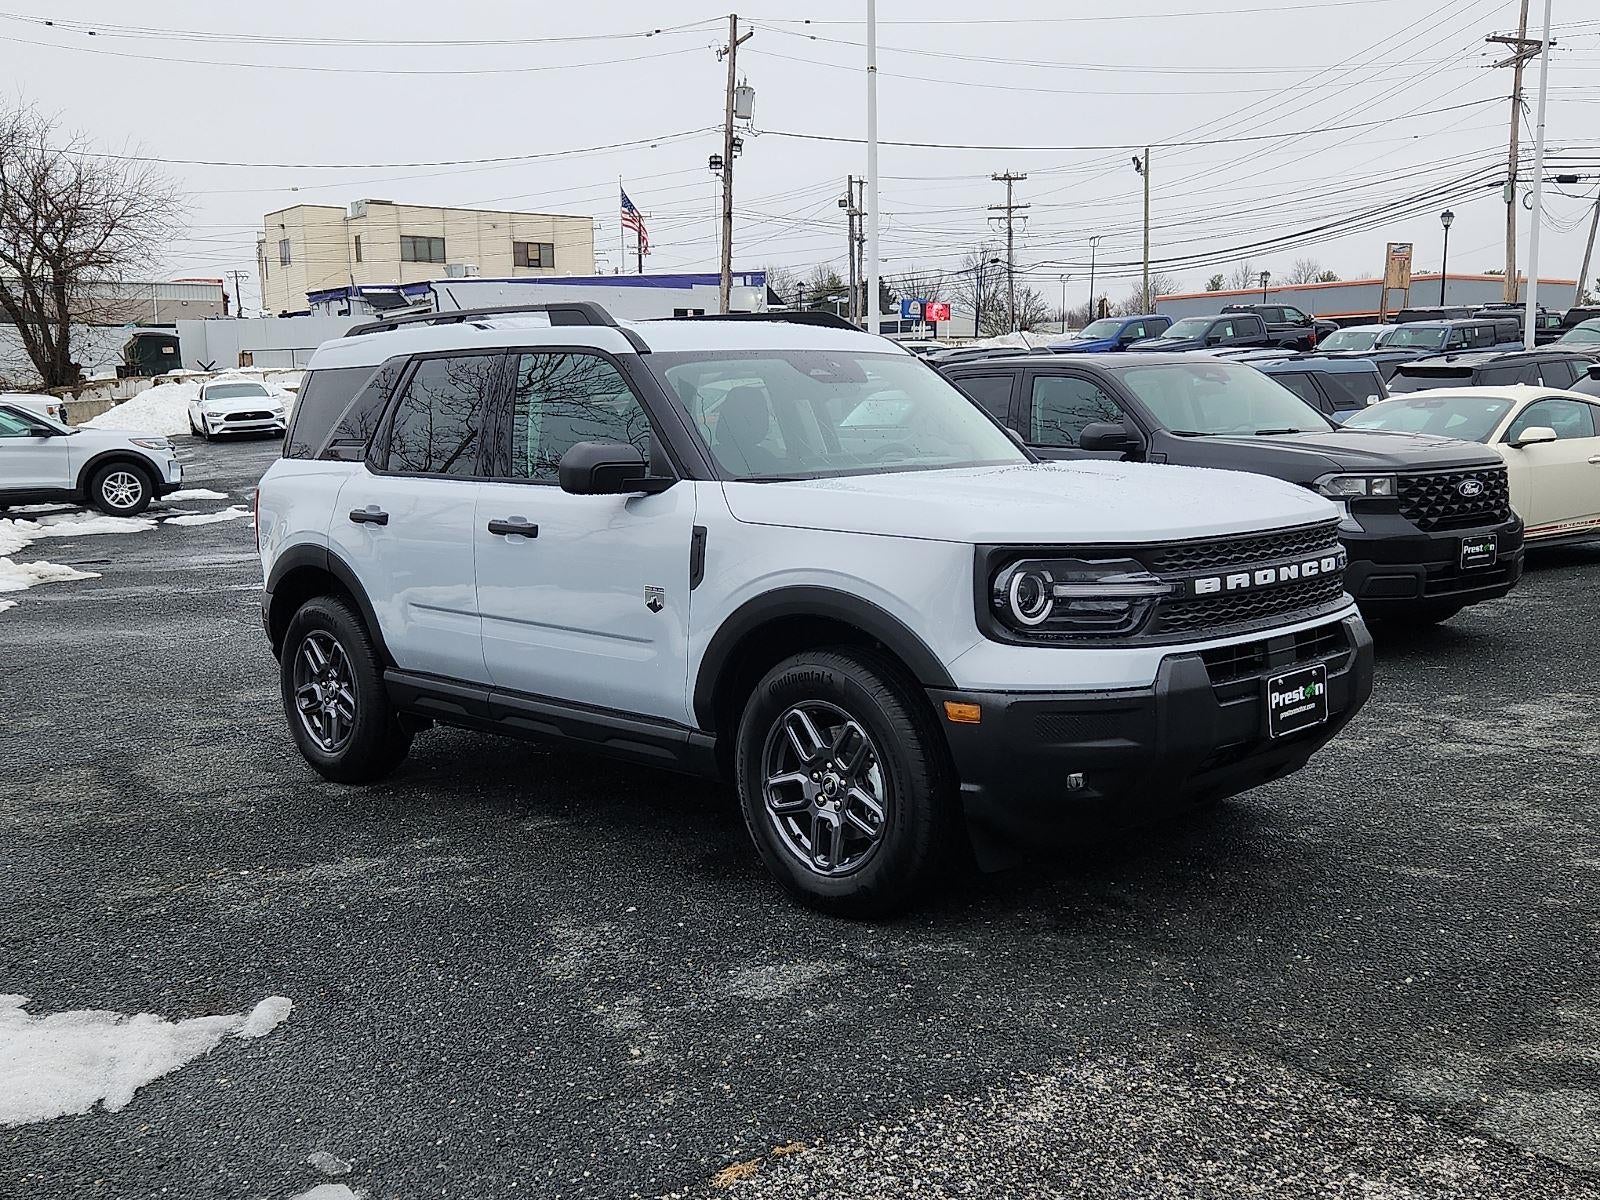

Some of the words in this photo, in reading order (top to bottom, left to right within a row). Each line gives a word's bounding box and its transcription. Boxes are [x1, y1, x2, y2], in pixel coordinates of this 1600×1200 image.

[1463, 482, 1480, 494] Ford
[1194, 556, 1336, 595] BRONCO
[768, 670, 826, 696] Continental
